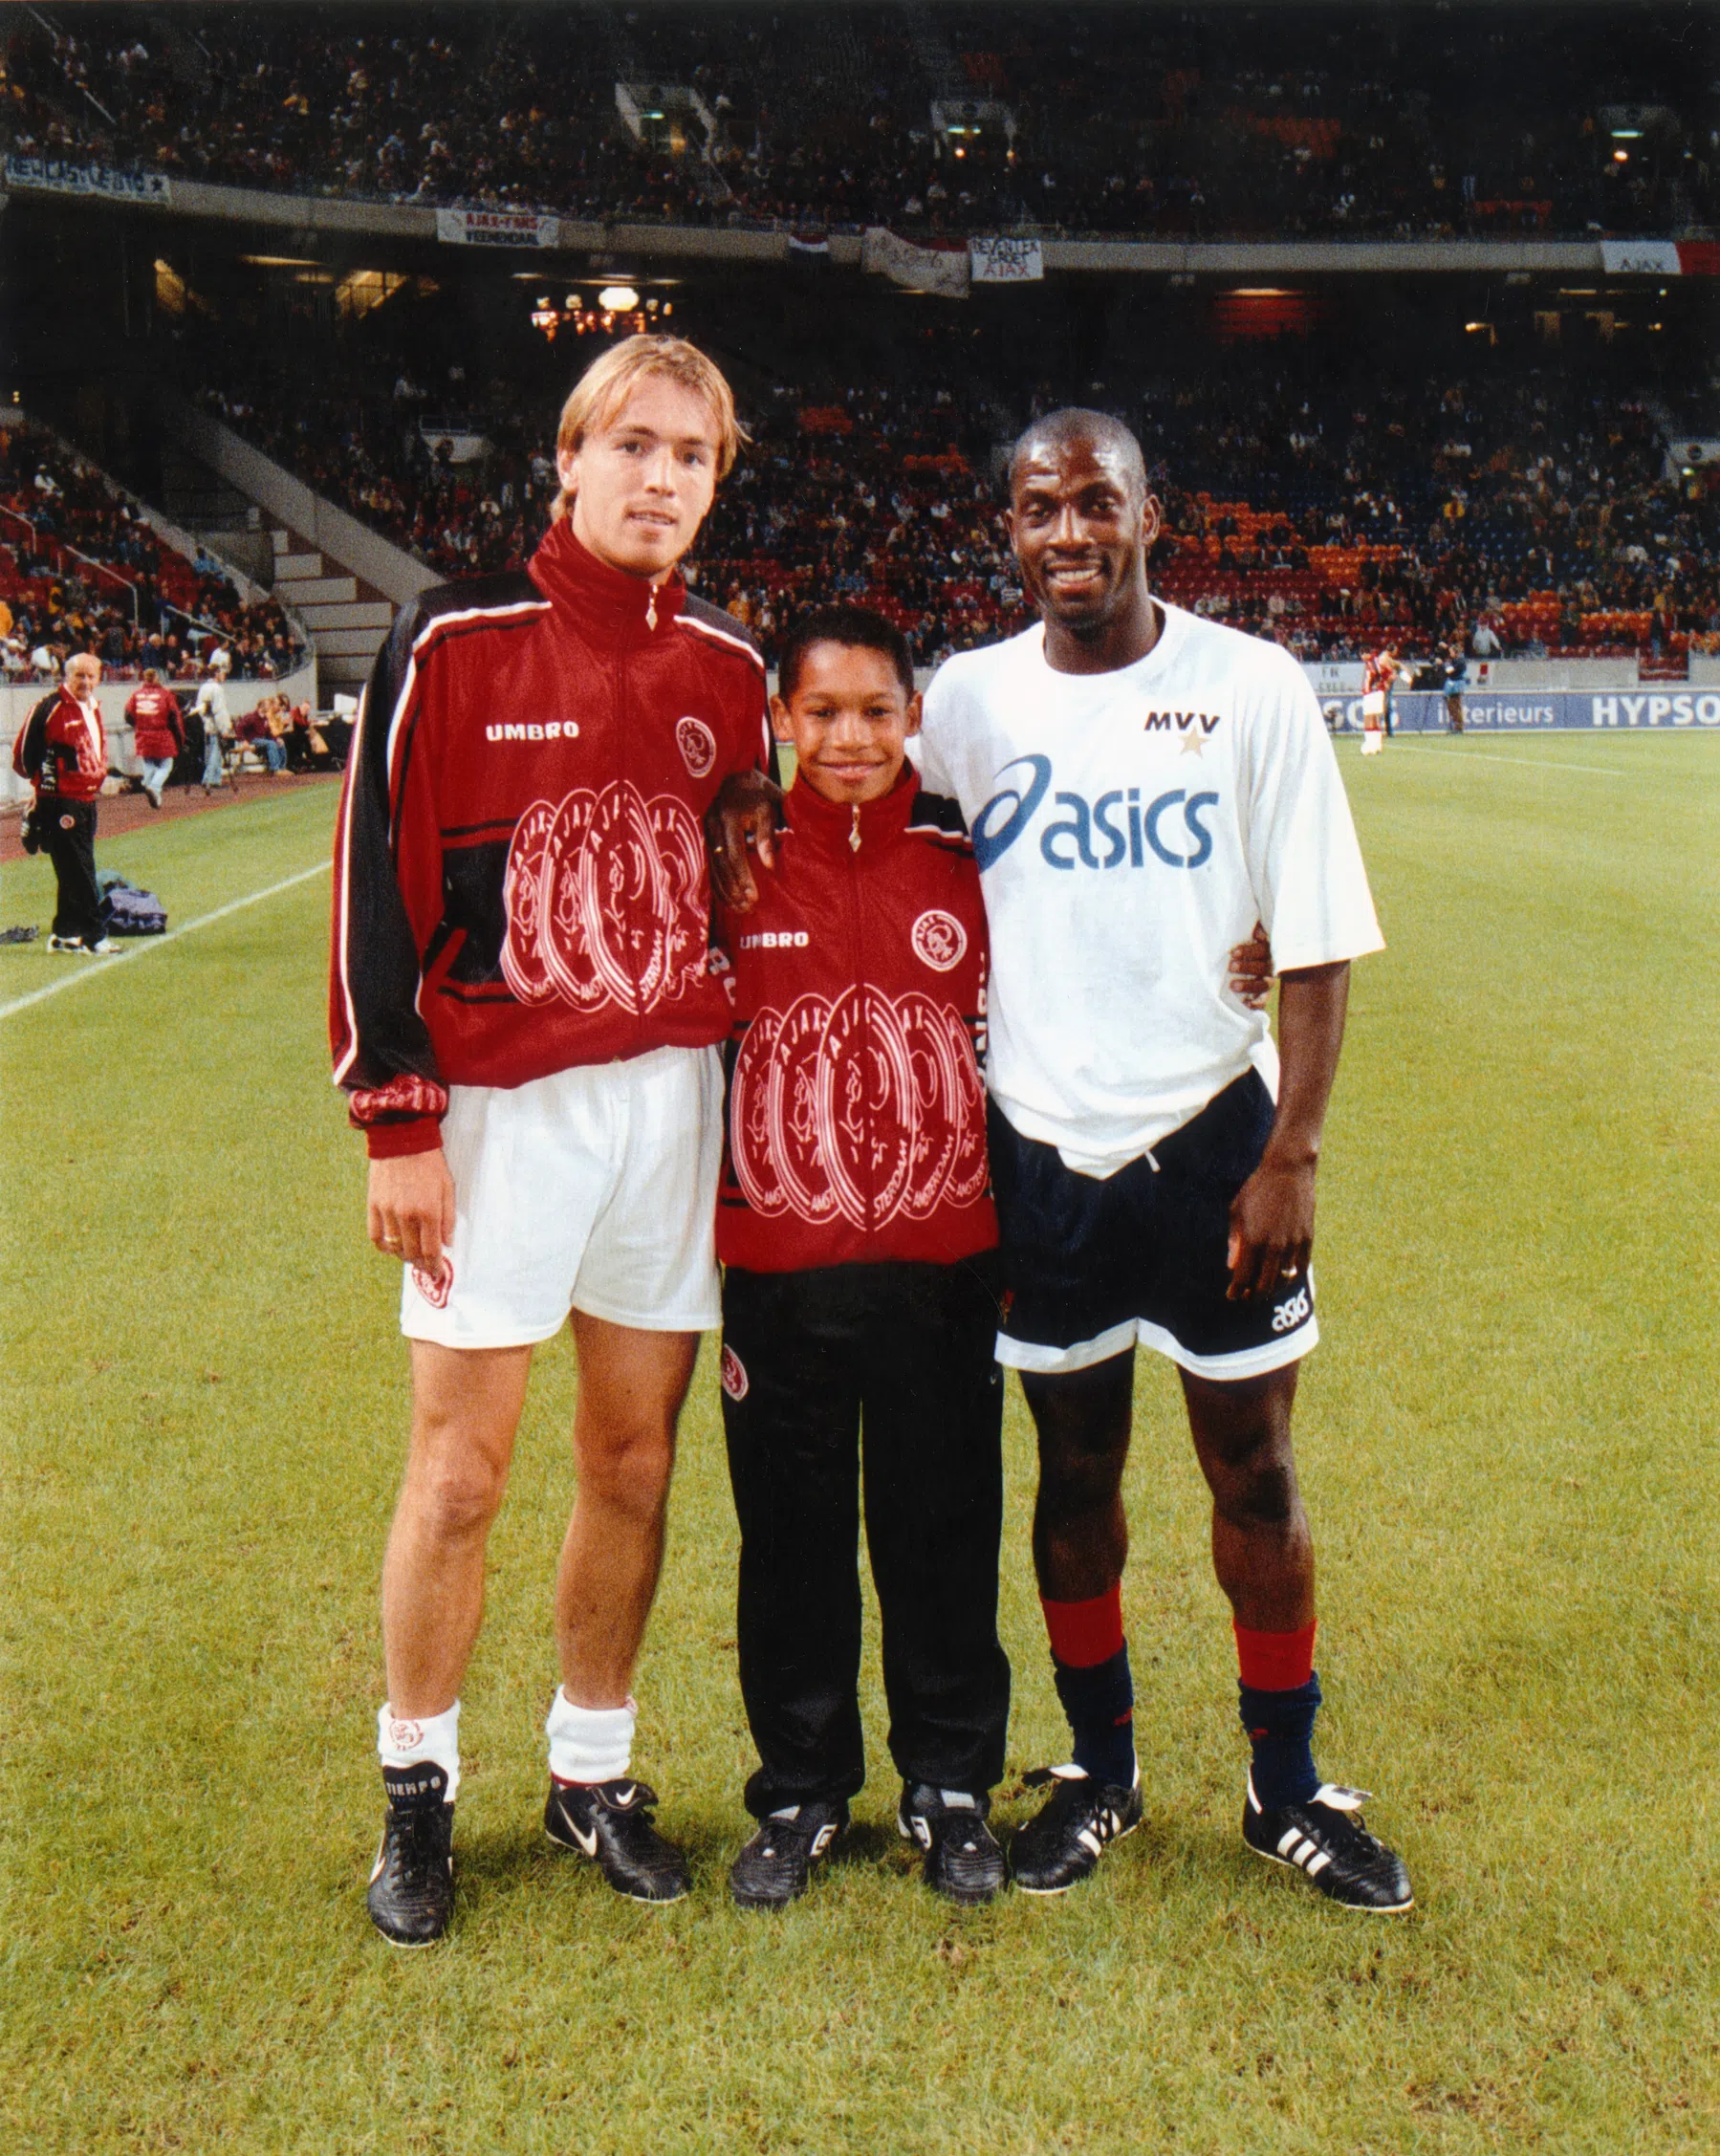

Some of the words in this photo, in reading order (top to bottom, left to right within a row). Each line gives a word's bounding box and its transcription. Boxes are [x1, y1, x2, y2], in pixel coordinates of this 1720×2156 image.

[983, 264, 1031, 278] AJAX
[1144, 711, 1220, 733] MVV
[1437, 701, 1554, 725] iterieurs
[486, 721, 579, 741] UMBRO
[1040, 787, 1219, 869] asics
[386, 1775, 442, 1797] TIEMPO
